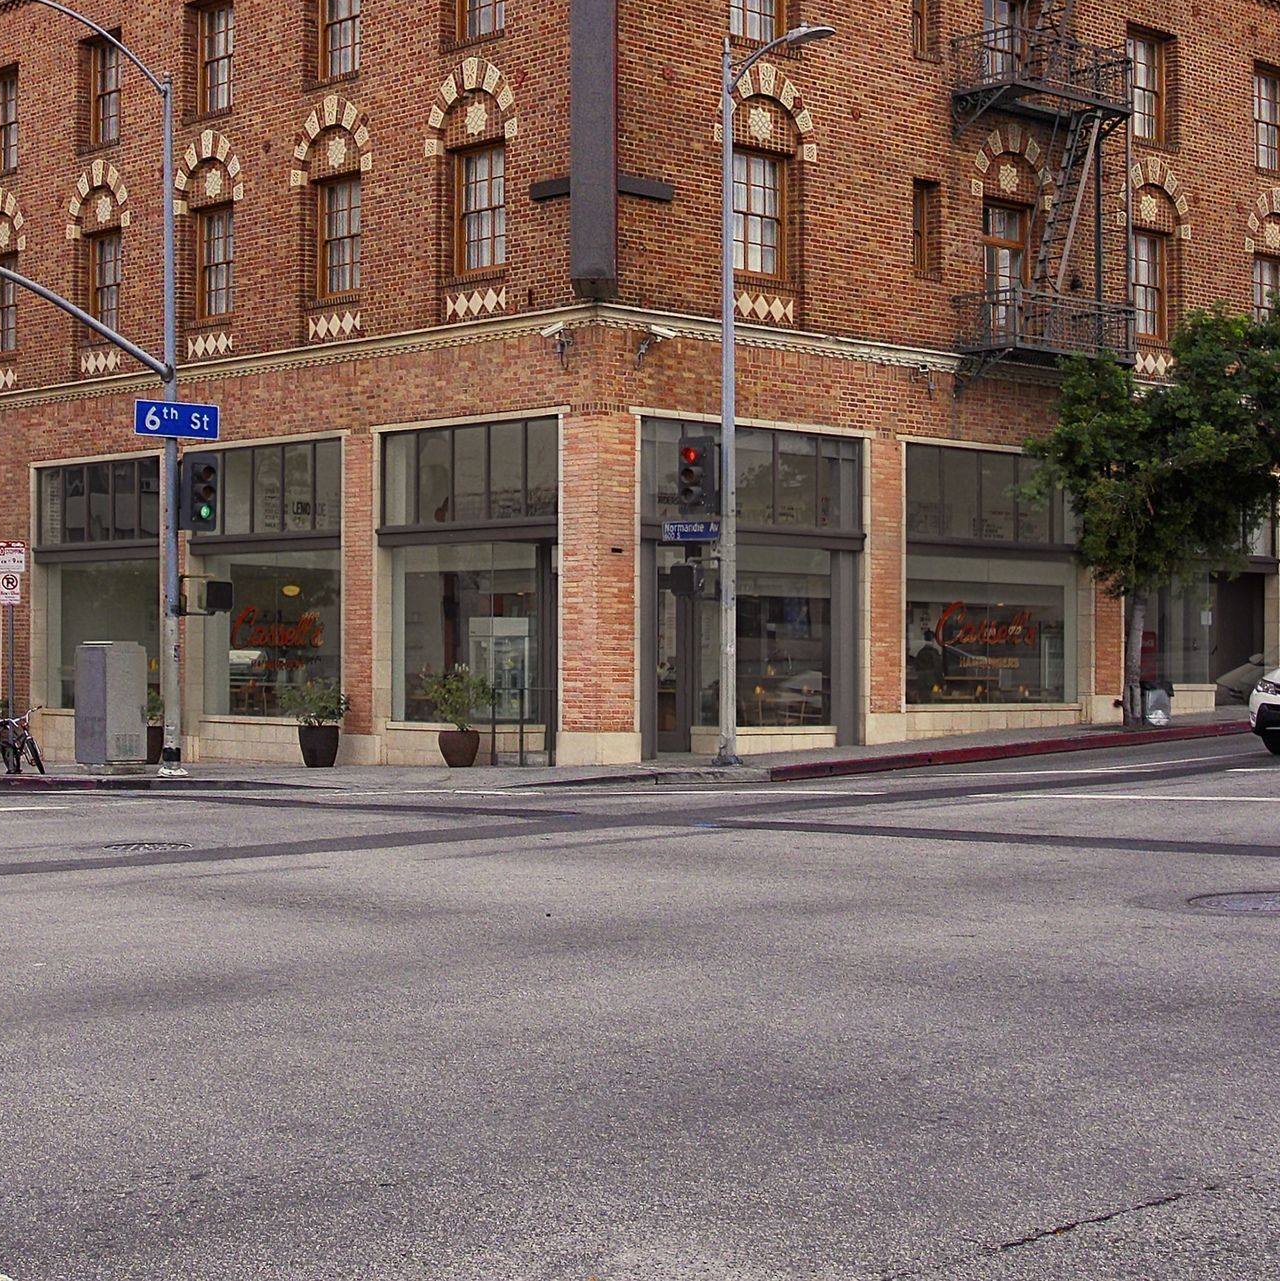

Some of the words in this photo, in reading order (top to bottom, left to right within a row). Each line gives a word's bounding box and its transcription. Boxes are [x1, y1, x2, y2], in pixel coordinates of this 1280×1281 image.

[145, 406, 178, 431] 6th
[190, 413, 210, 431] St
[664, 522, 704, 532] Normandie
[231, 606, 324, 649] Cassell's
